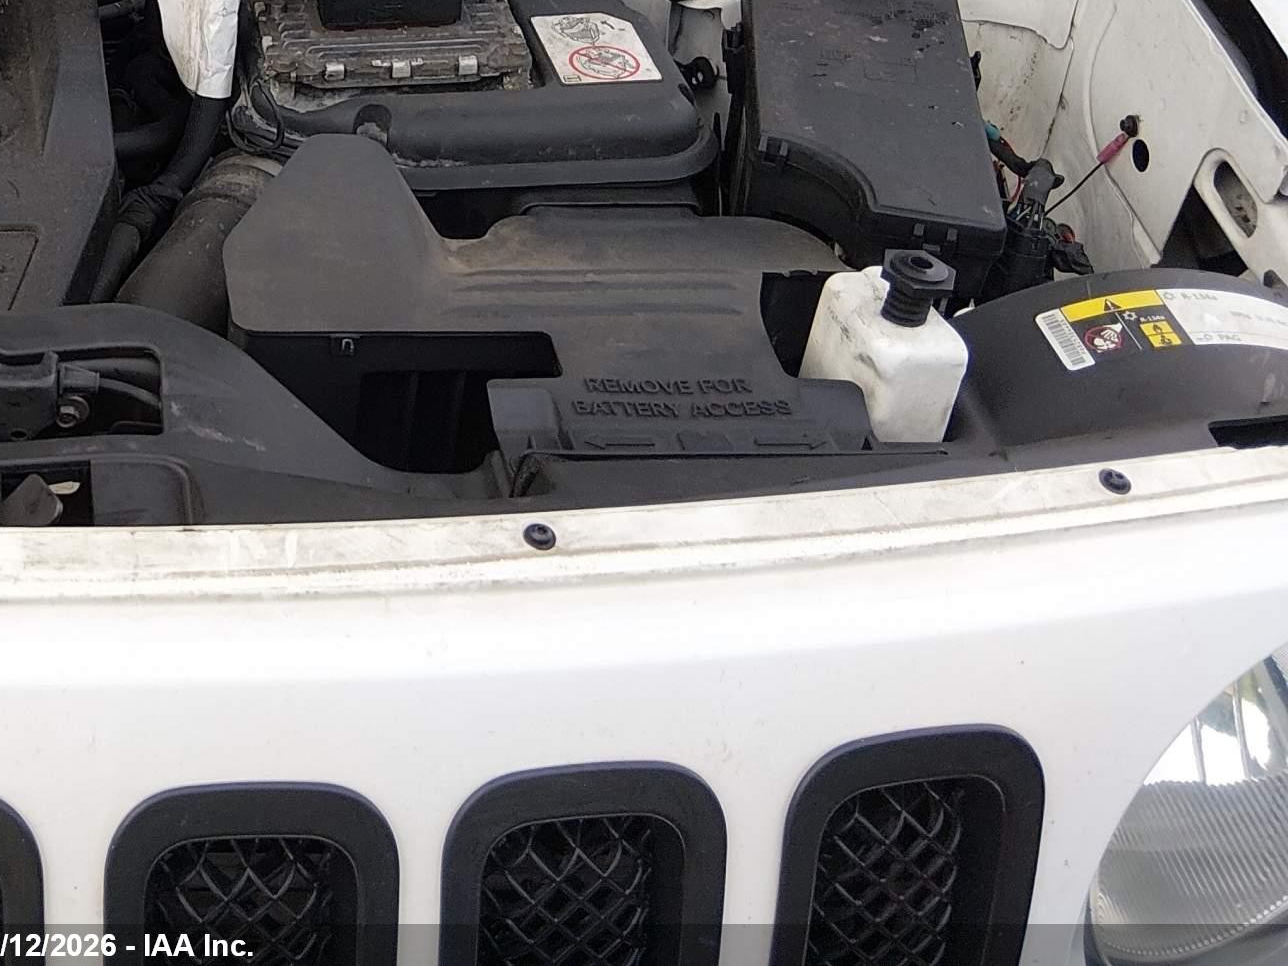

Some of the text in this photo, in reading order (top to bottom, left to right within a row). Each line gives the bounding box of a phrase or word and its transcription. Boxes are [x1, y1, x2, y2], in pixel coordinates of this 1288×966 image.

[583, 378, 753, 395] REMOVE FOR
[572, 399, 793, 418] BATTERY ACCESS
